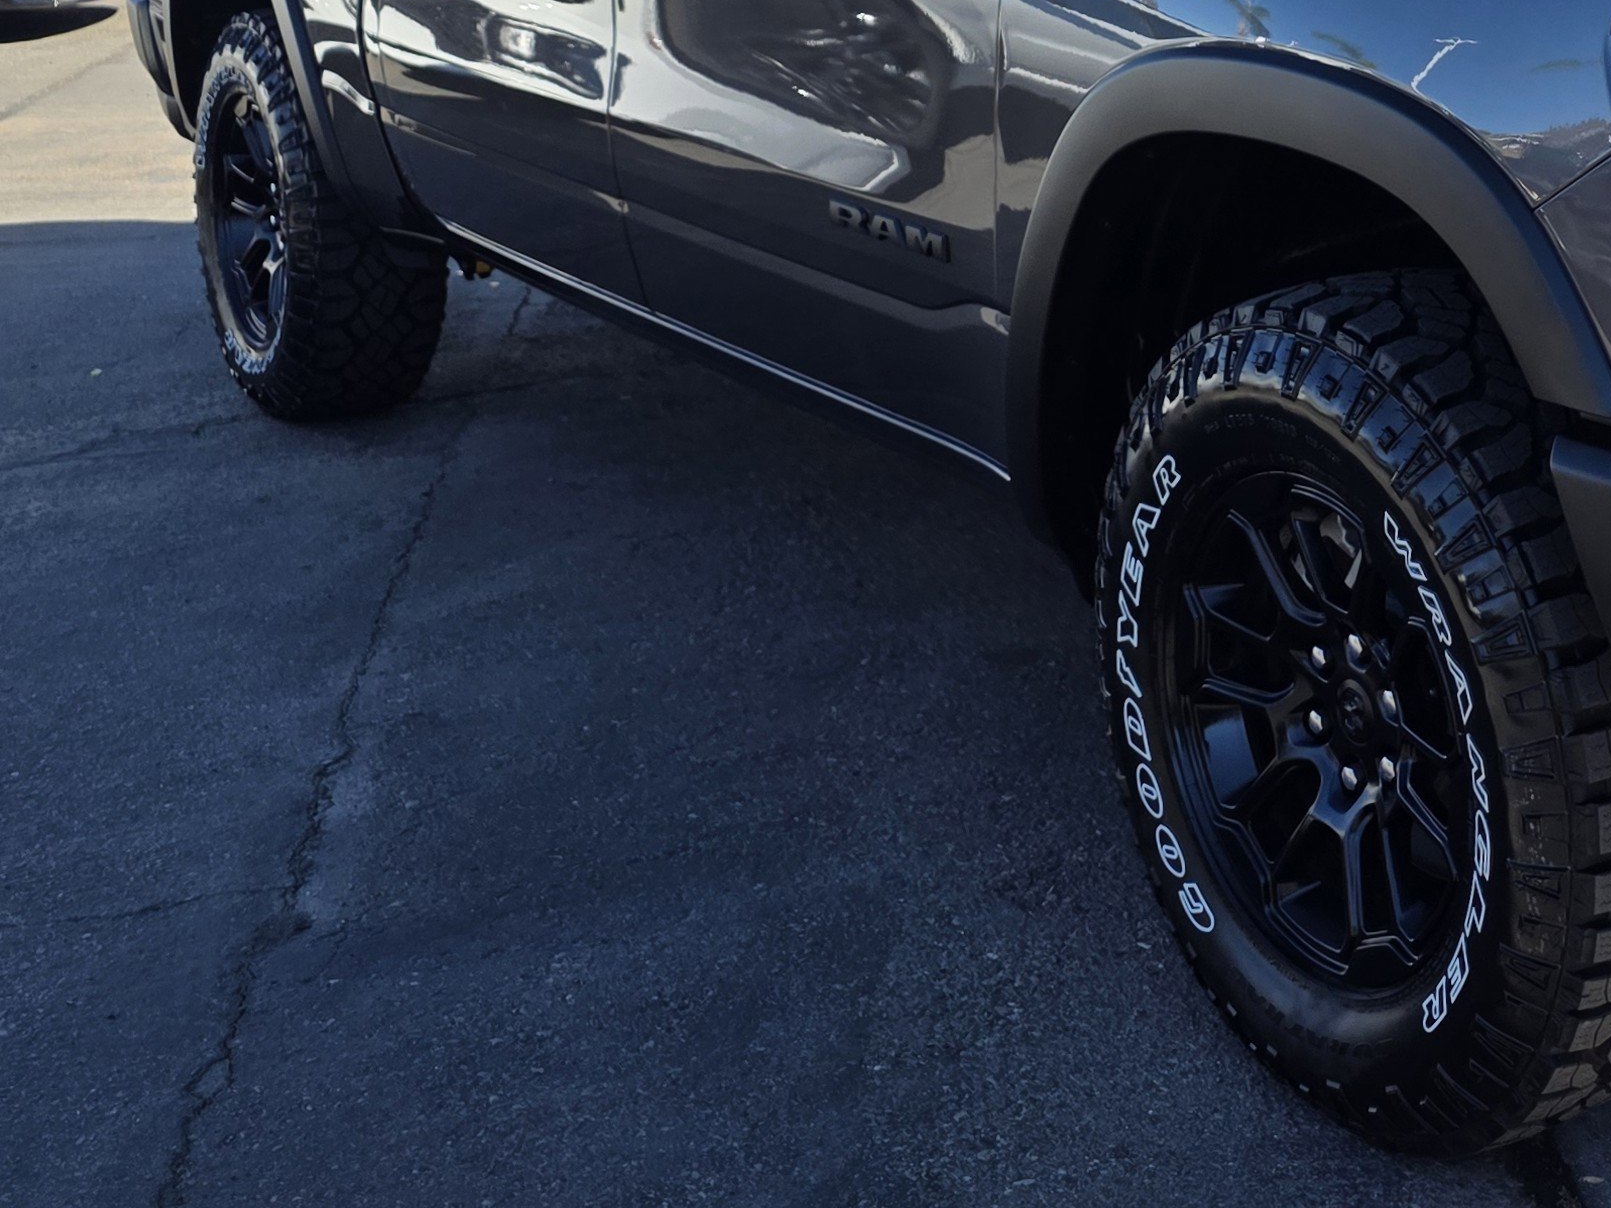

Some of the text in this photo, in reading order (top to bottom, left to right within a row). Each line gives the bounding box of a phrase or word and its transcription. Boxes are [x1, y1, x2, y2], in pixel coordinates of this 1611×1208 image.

[828, 199, 952, 264] RAM
[1115, 453, 1215, 934] GOODYEAR
[1383, 509, 1492, 1034] WRANGLER
